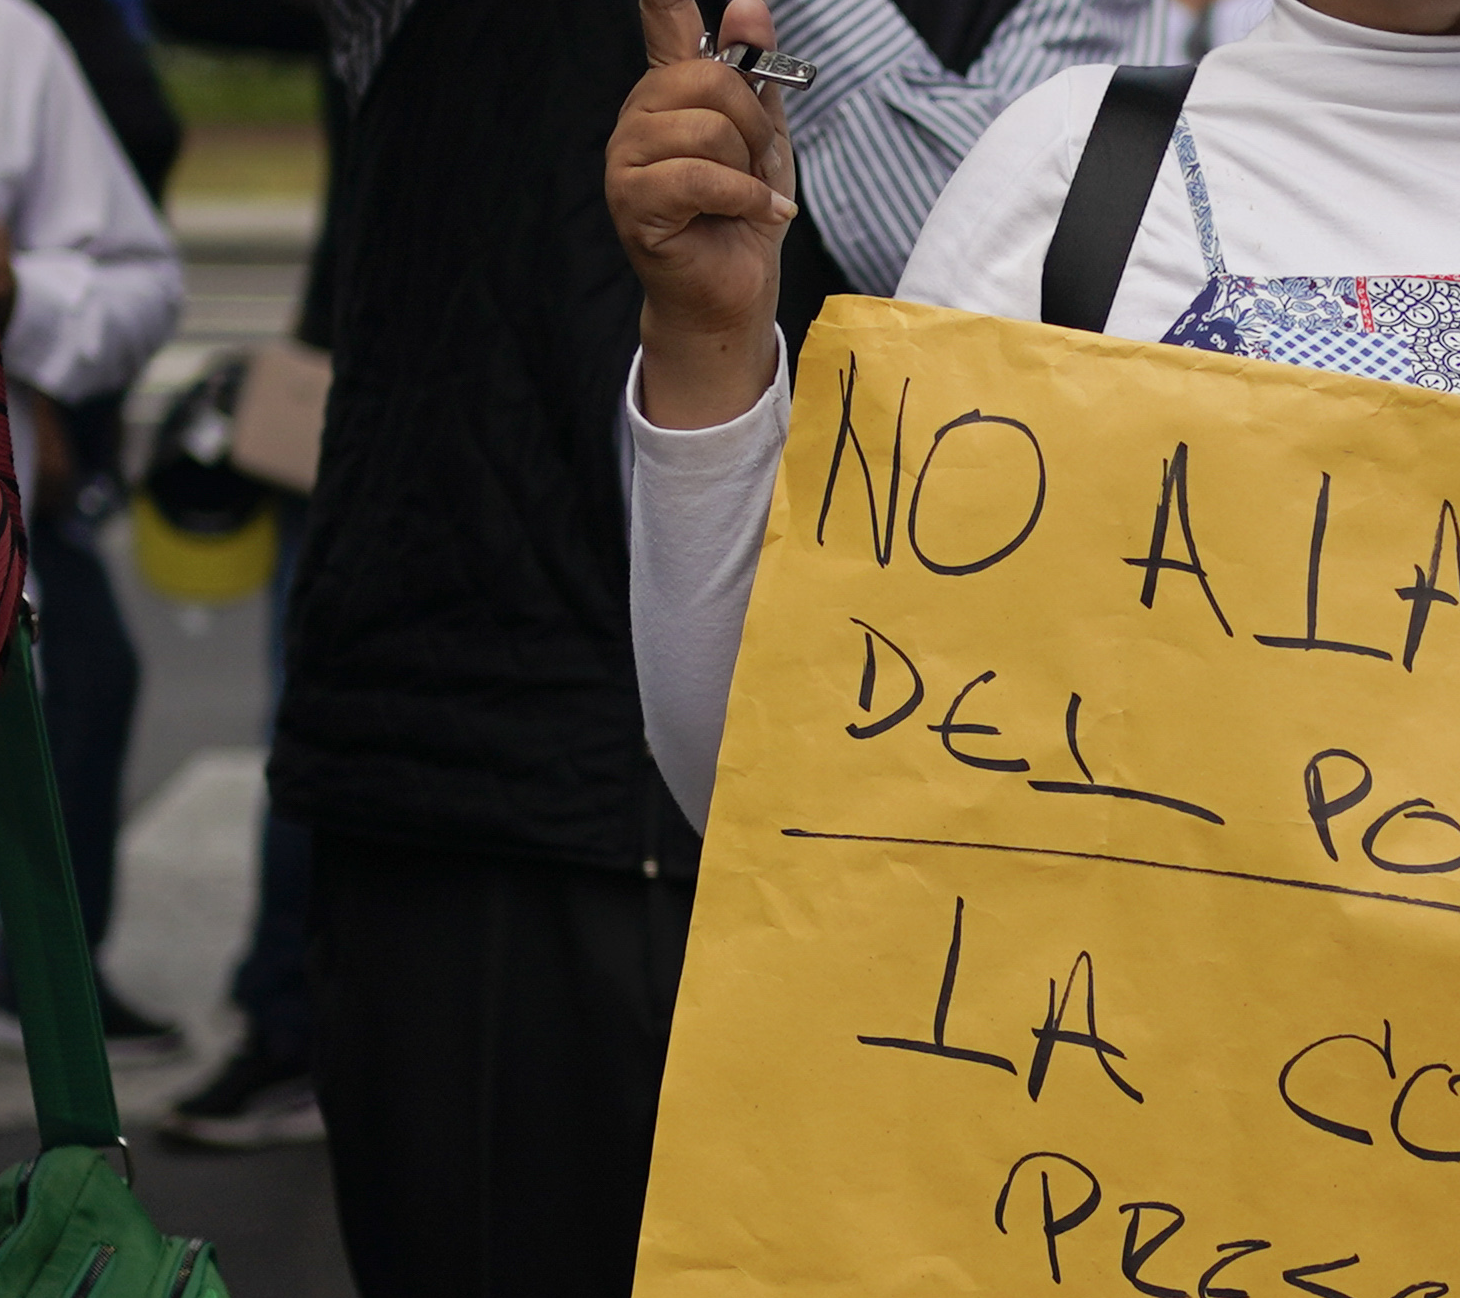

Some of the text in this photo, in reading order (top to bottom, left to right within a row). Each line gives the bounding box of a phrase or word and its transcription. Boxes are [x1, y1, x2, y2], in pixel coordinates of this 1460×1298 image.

[816, 348, 1048, 578] NO
[1120, 440, 1235, 639] A
[843, 616, 1228, 827] DEL
[856, 894, 1146, 1106] LA
